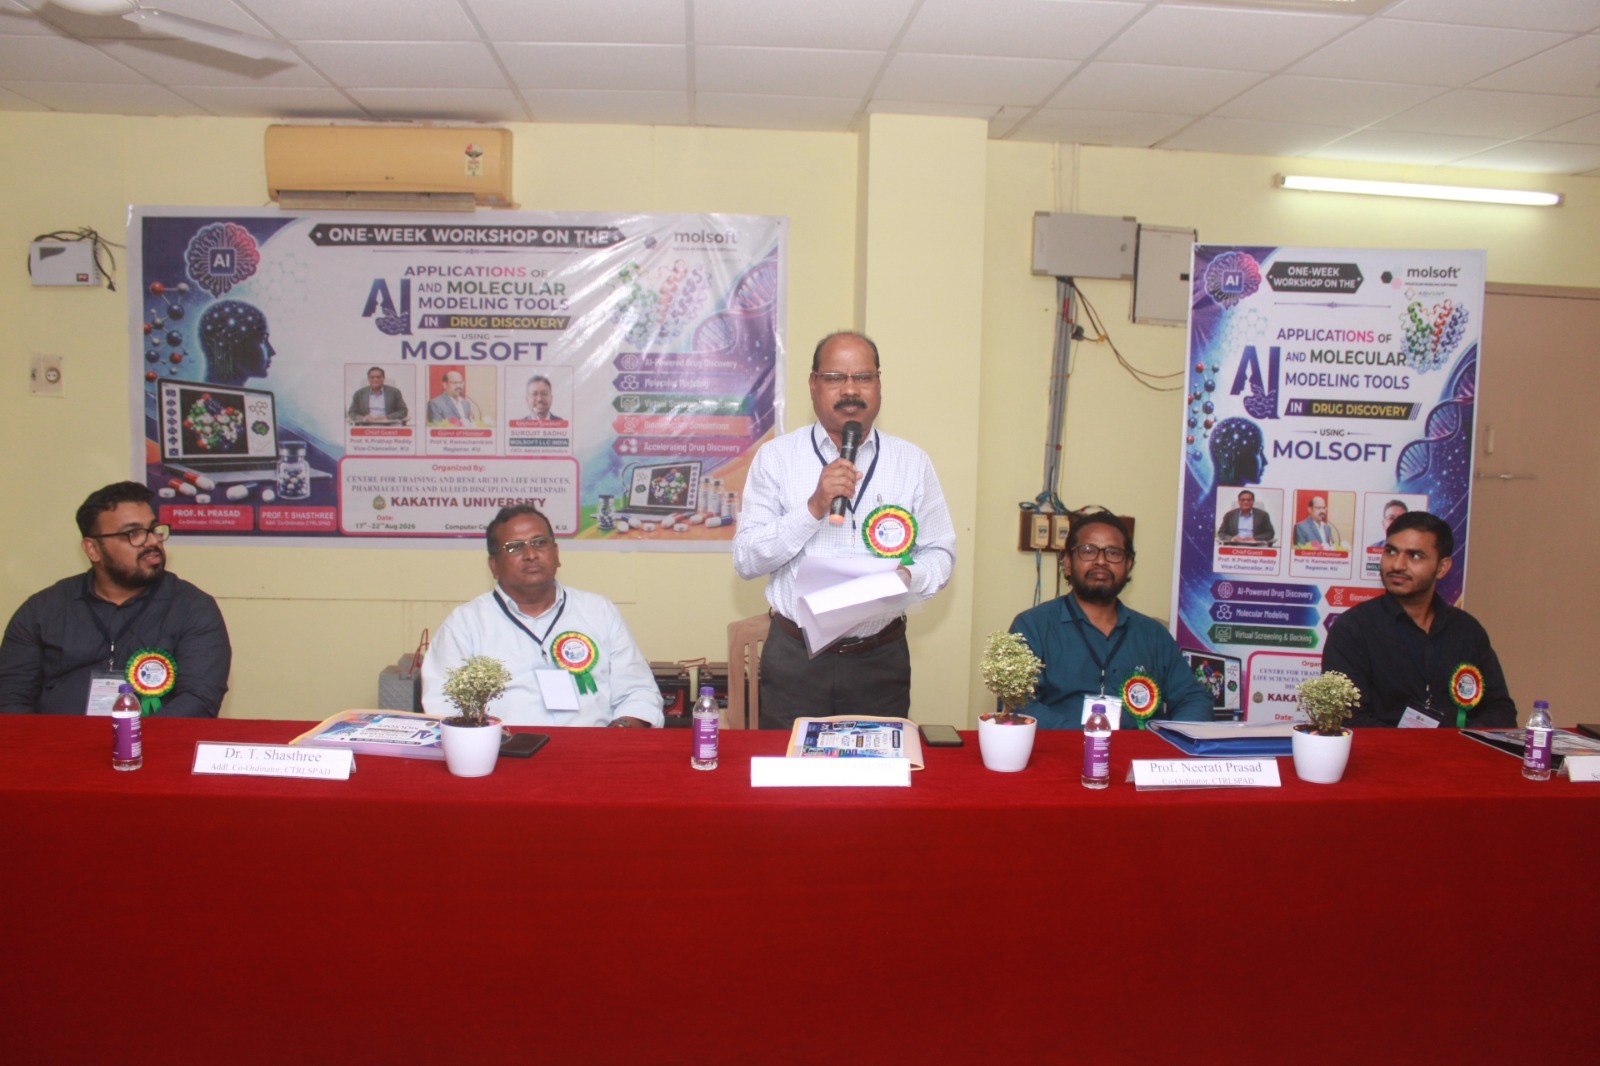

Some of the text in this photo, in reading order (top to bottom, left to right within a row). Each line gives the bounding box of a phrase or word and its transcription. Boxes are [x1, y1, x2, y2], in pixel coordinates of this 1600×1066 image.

[328, 227, 609, 245] ONE-WEEK WORKSHOP ON THE
[674, 230, 738, 244] molsoft
[213, 254, 230, 268] AI
[404, 265, 548, 278] APPLICATIONS OF
[1287, 265, 1340, 277] ONE-WEEK
[1407, 265, 1458, 279] molsoft
[1225, 275, 1239, 287] AI
[1273, 277, 1356, 289] WORKSHOP ON THE
[418, 281, 566, 296] AND MOLECULAR
[361, 278, 414, 336] AI
[418, 297, 570, 311] MODELING TOOLS
[424, 317, 566, 329] IN DRUG DISCOVERY
[1277, 328, 1392, 344] APPLICATIONS OF
[401, 340, 548, 361] MOLSOFT
[1285, 349, 1407, 366] AND MOLECULAR
[703, 361, 738, 370] Discovery
[1230, 345, 1281, 419] AI
[1285, 372, 1410, 390] MODELING TOOLS
[1290, 402, 1408, 417] IN DRUG DISCOVERY
[510, 429, 567, 437] SUROJIT SADHU
[1319, 428, 1345, 437] USING
[643, 443, 741, 454] Accelerating Drug Discovery
[1273, 440, 1392, 462] MOLSOFT
[431, 464, 486, 474] Organized By:
[346, 475, 379, 483] CENTRE
[439, 476, 455, 484] AND
[351, 485, 420, 493] PHARMACEUTICS
[469, 486, 519, 494] DISCIPLINES
[390, 497, 546, 508] KAKATIYA UNIVERSITY
[172, 509, 197, 517] PROF.
[207, 509, 241, 518] PRASAD
[261, 511, 282, 519] PROF.
[291, 512, 335, 520] SHASTHREE
[385, 523, 398, 531] Aug
[444, 524, 477, 532] Computer
[1259, 558, 1277, 566] Reddy
[1237, 587, 1314, 601] AI-Powered Drug Discovery
[1235, 608, 1290, 621] Molecular Modeling
[1234, 629, 1313, 644] Virtual Screening & Docking
[1301, 660, 1323, 669] Organ
[1252, 674, 1268, 682] LIFE
[1259, 667, 1321, 677] CENTRE FOR TRAIN
[1267, 692, 1298, 703] KAKA
[1274, 713, 1295, 721] Date:
[224, 746, 322, 763] Dr. T. Shasthree
[284, 765, 331, 776] CTRLSPAD
[1149, 761, 1263, 774] Prof. Neerati Prasad
[1211, 777, 1255, 785] CTRLSPAD
